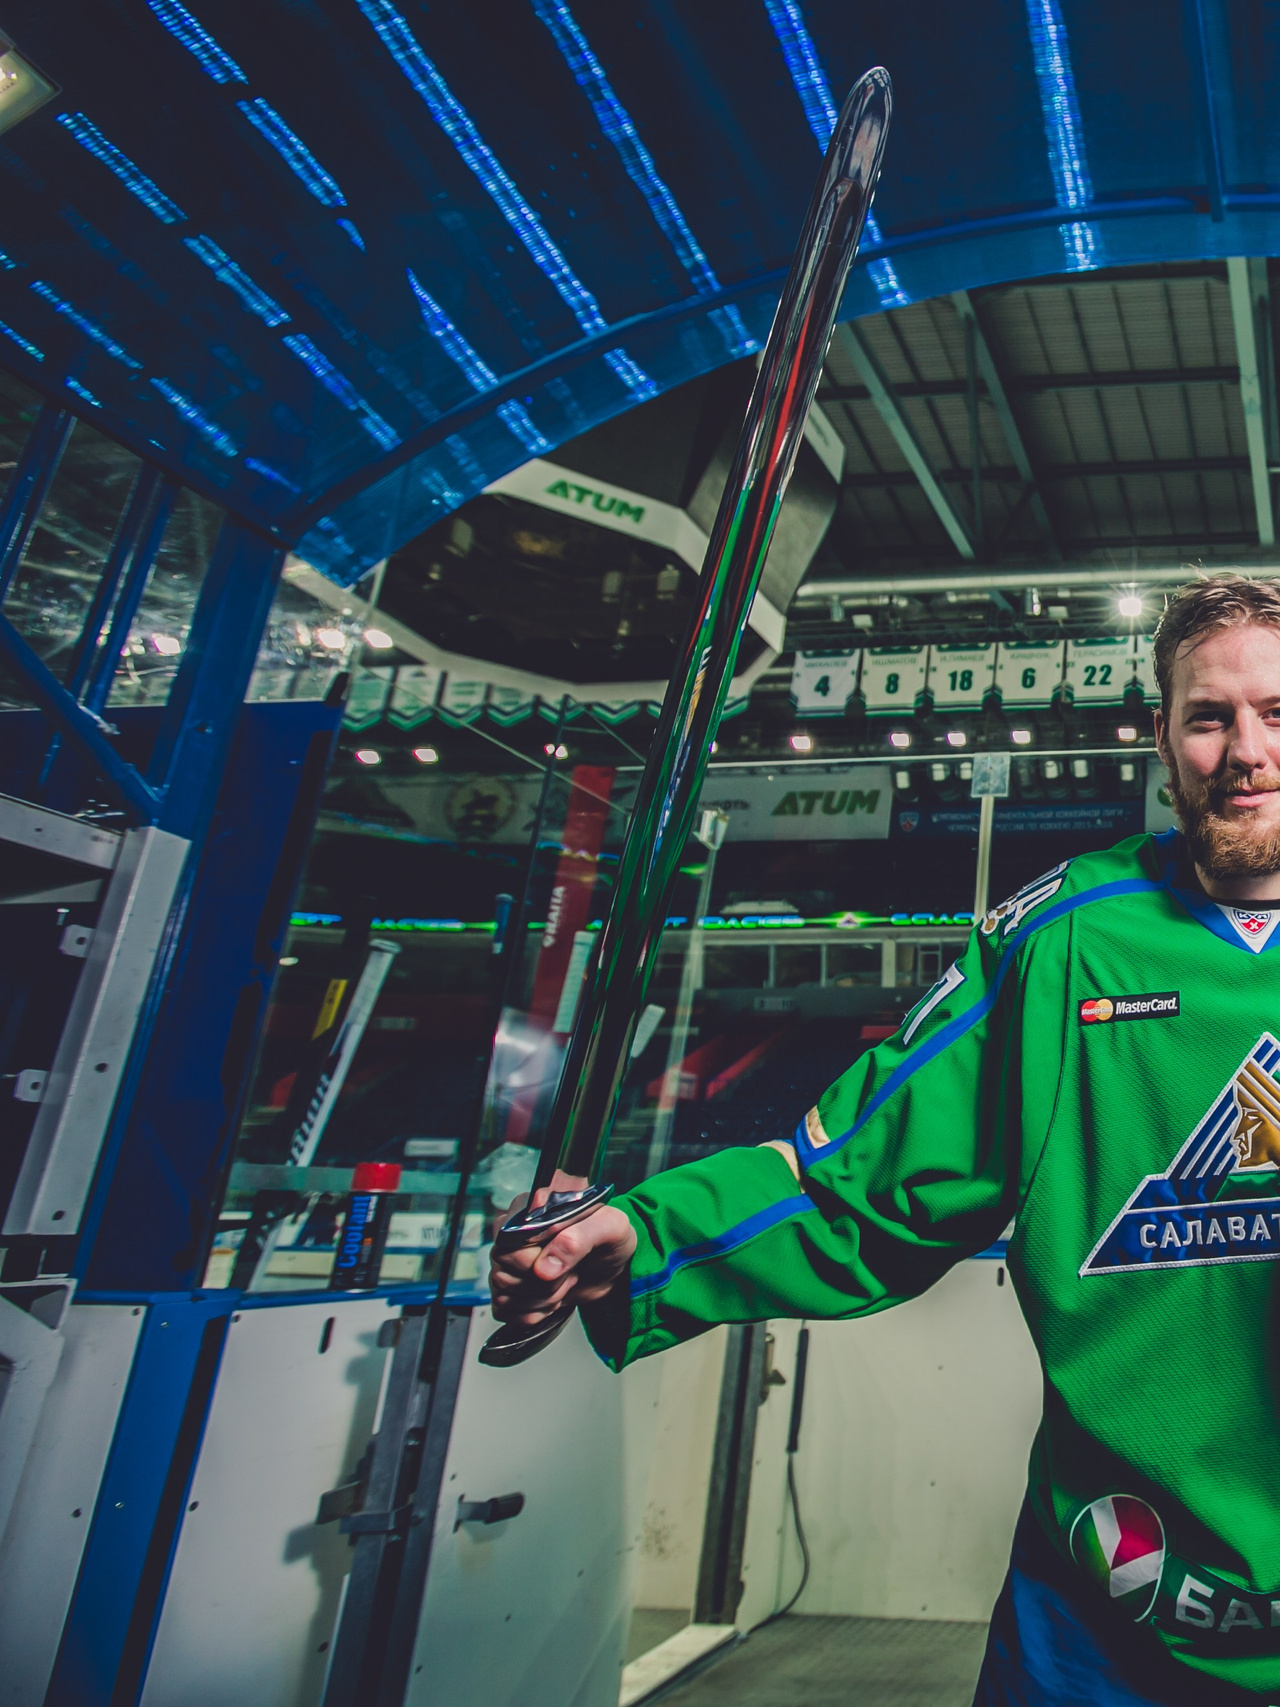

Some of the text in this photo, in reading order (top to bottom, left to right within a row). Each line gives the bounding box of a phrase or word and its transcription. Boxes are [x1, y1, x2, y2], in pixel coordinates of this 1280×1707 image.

[546, 479, 646, 524] ATUM
[814, 675, 830, 697] 4
[885, 673, 899, 694] 8
[948, 669, 973, 691] 18
[1021, 667, 1036, 689] 6
[1083, 664, 1112, 686] 22
[770, 789, 881, 816] ATUM
